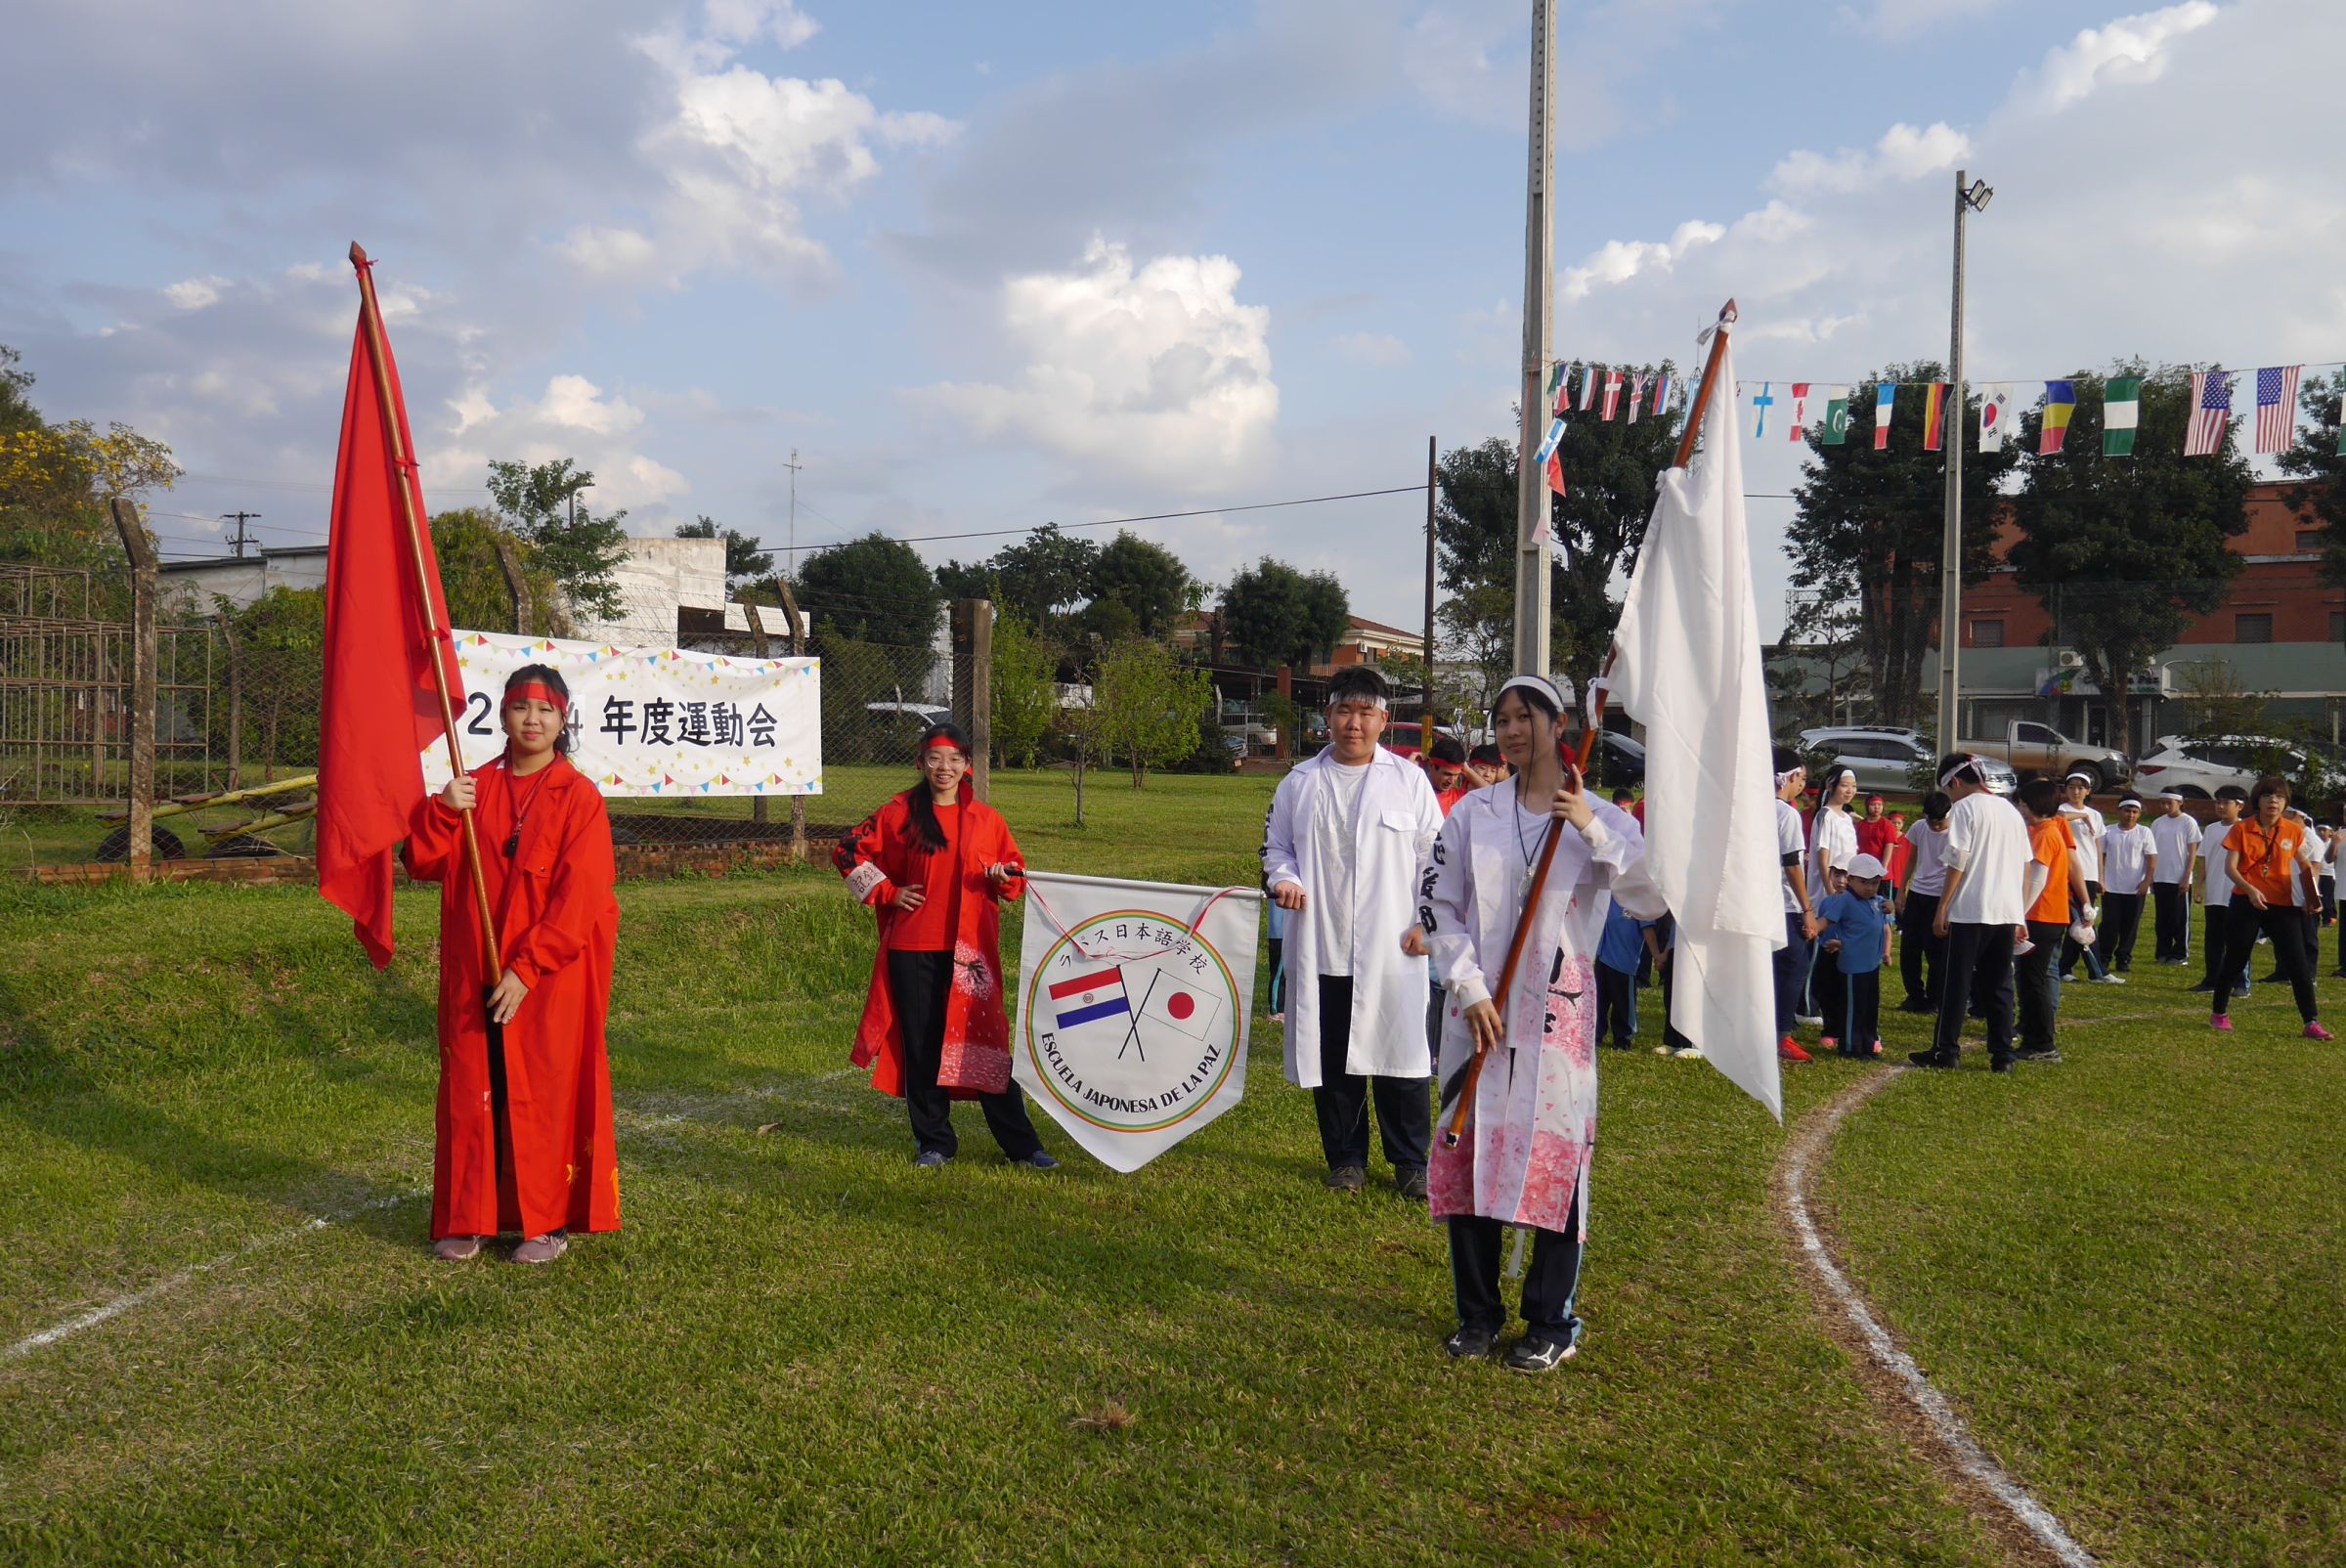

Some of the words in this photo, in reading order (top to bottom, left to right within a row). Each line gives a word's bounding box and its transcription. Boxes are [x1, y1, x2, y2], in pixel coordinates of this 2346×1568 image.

[467, 691, 778, 748] 24年度運動会
[1041, 1032, 1083, 1093] ESCUELA
[1082, 1088, 1158, 1113] JAPONESA
[1160, 1087, 1184, 1108] DE
[1182, 1073, 1203, 1094] LA
[1197, 1043, 1222, 1076] PAZ
